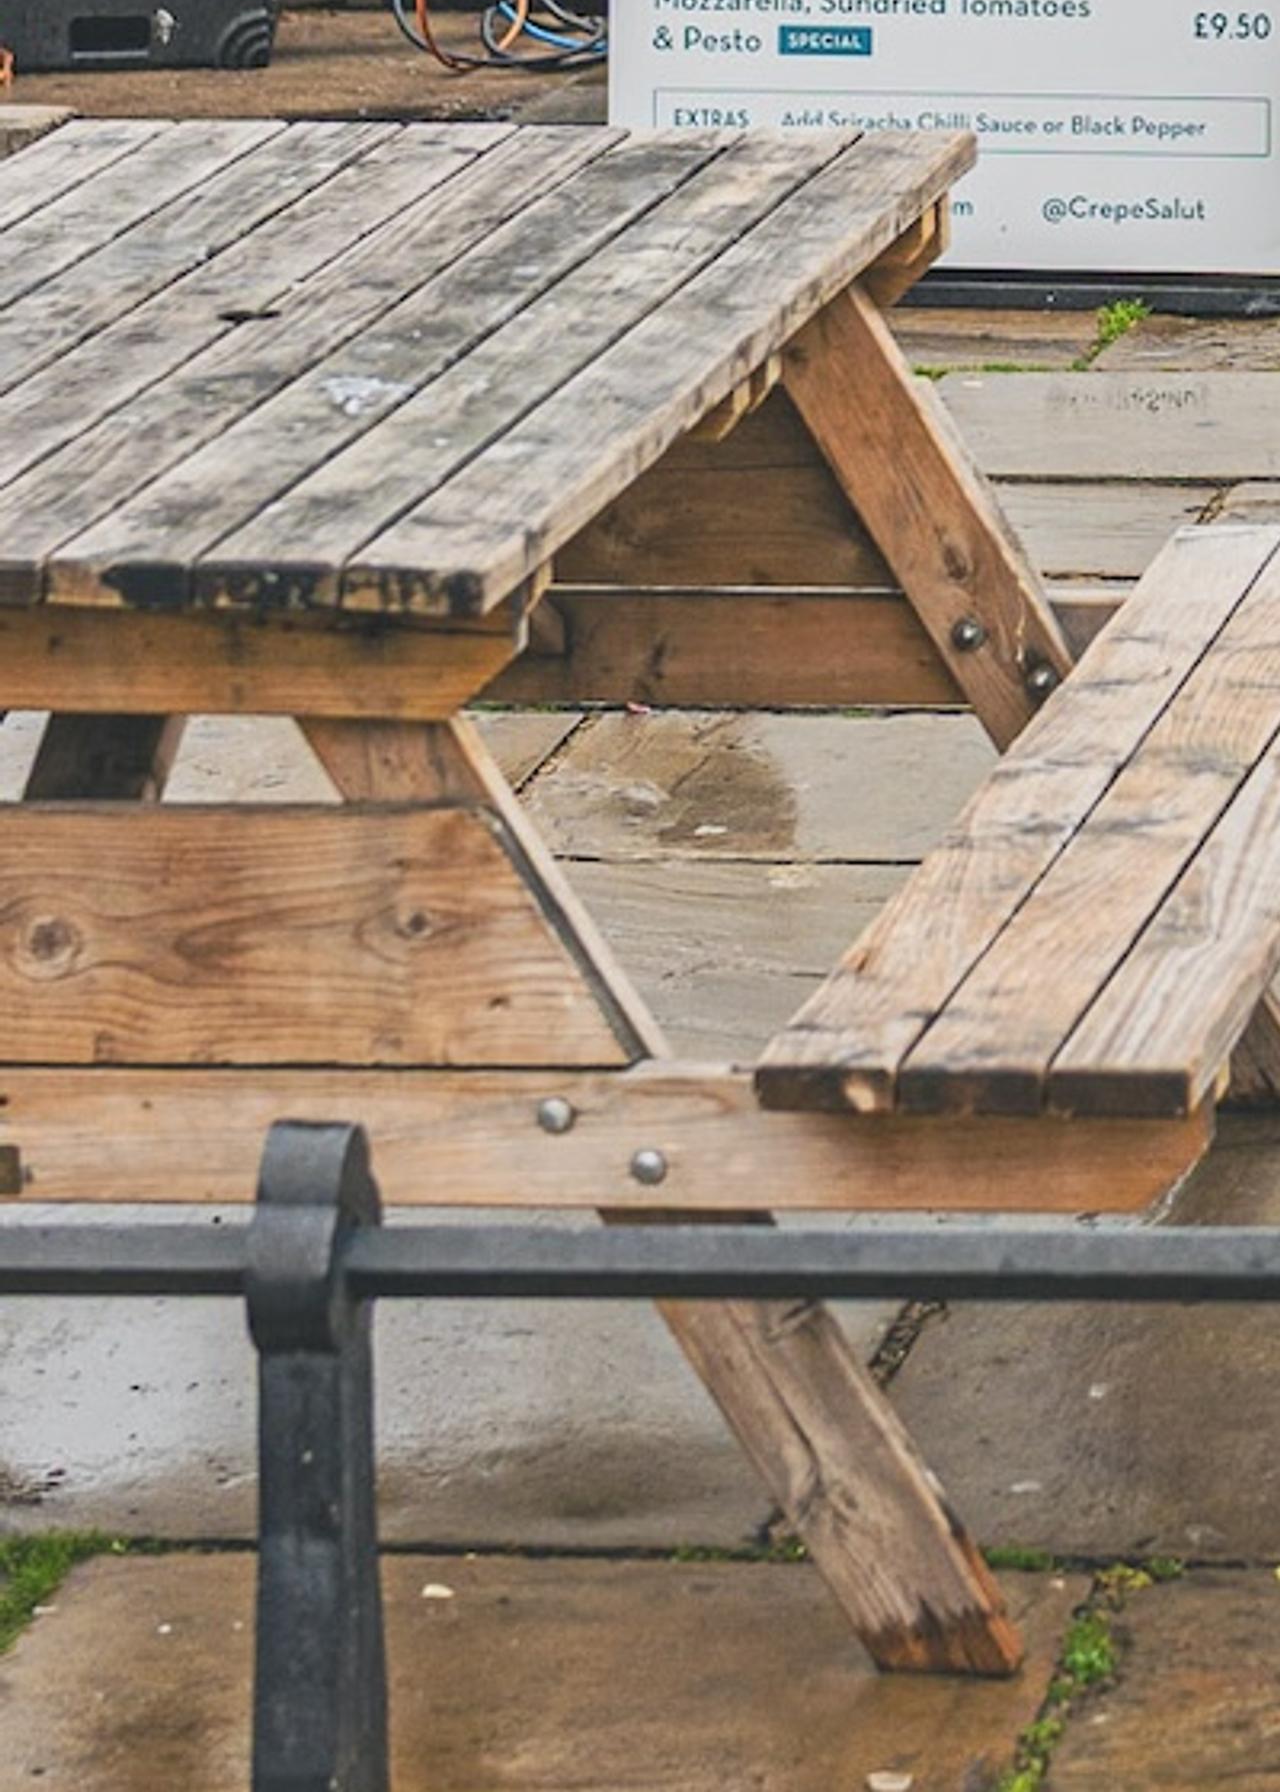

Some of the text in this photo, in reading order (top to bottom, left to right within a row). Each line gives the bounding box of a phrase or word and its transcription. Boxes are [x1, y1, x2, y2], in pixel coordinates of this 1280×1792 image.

[653, 26, 862, 52] & Pesto SPECIAL
[1195, 13, 1270, 39] £9.50
[674, 108, 749, 129] EXTRAS
[976, 113, 1037, 133] Sauce
[1043, 121, 1064, 134] or
[1072, 116, 1124, 135] Black
[1132, 116, 1205, 139] Pepper
[1043, 196, 1204, 223] @CrepeSalut
